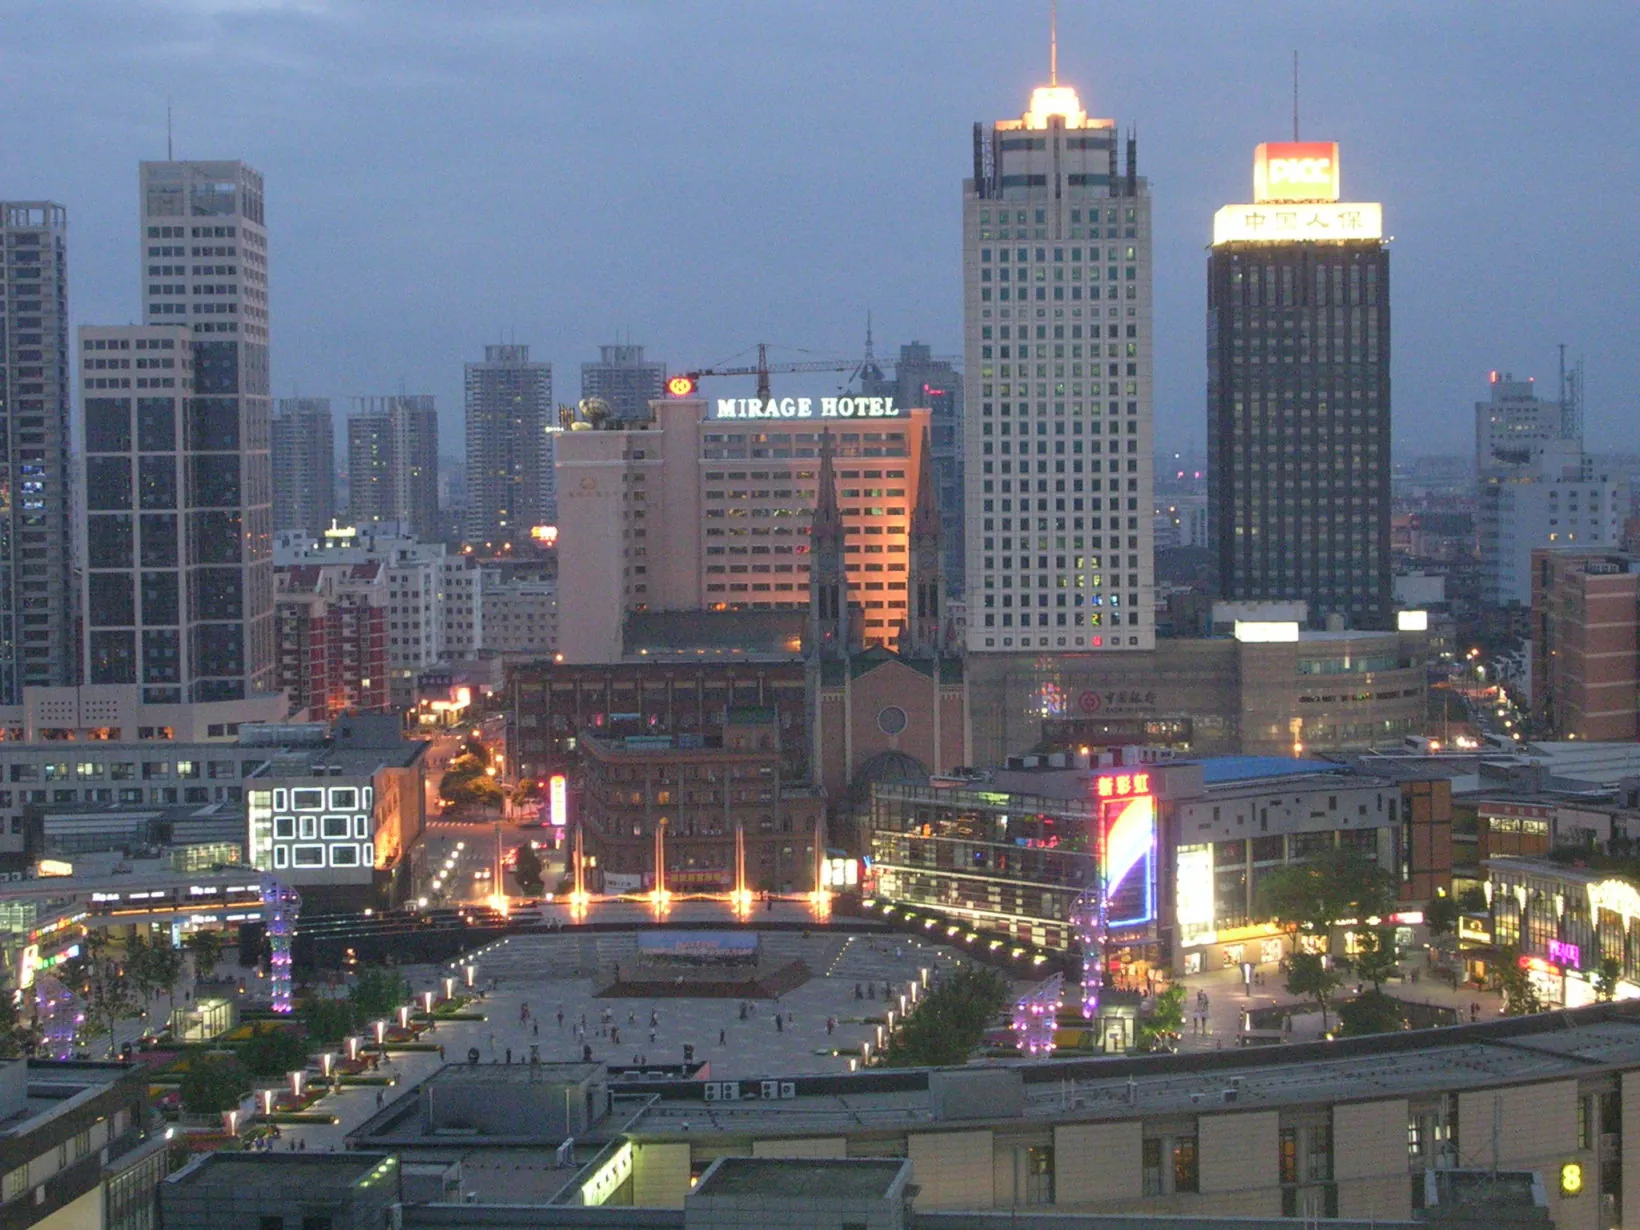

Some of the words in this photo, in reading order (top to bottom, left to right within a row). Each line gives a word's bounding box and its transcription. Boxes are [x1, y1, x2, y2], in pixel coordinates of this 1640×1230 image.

[1269, 158, 1331, 184] PICC
[717, 397, 812, 418] MIRAGE
[821, 397, 899, 417] HOTEL
[1562, 1164, 1581, 1191] 8
